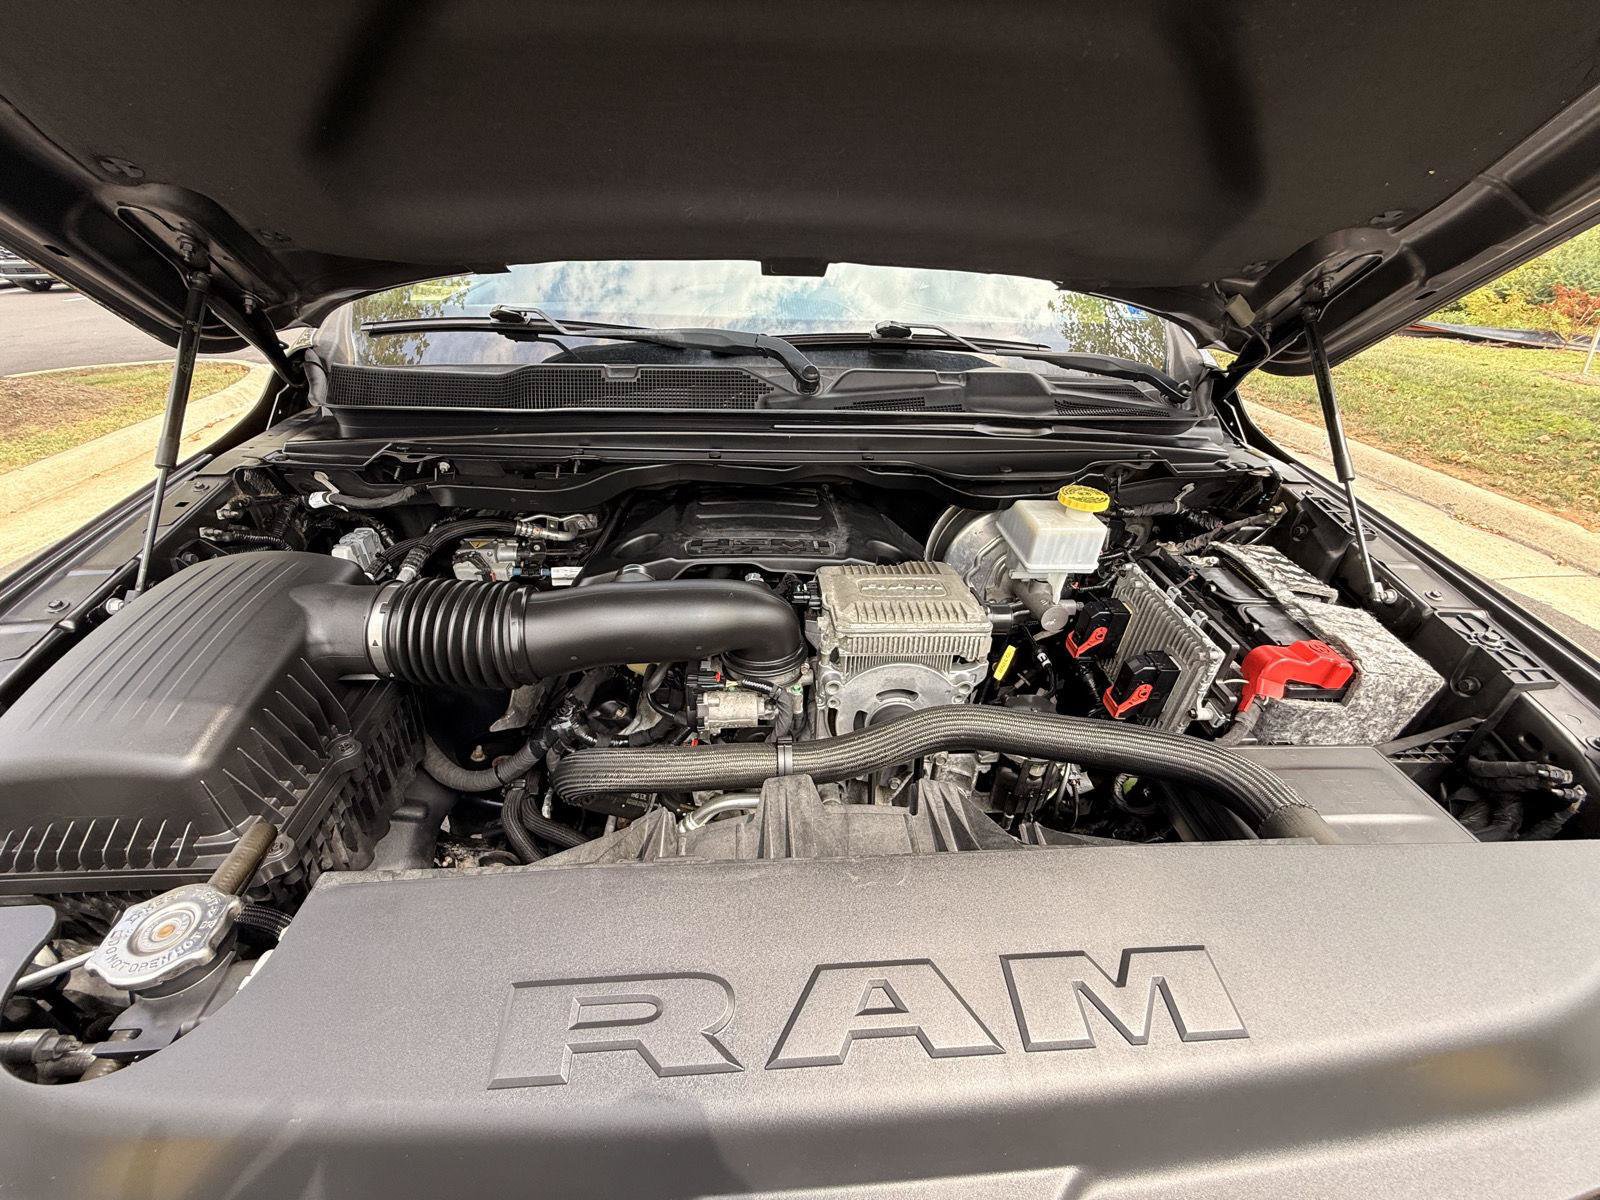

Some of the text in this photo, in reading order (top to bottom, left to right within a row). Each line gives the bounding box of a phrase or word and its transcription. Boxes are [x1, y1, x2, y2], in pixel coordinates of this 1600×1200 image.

[106, 954, 131, 971] NOT
[128, 952, 173, 973] OPEN
[175, 931, 202, 957] HOT
[487, 945, 1251, 1090] RAM
